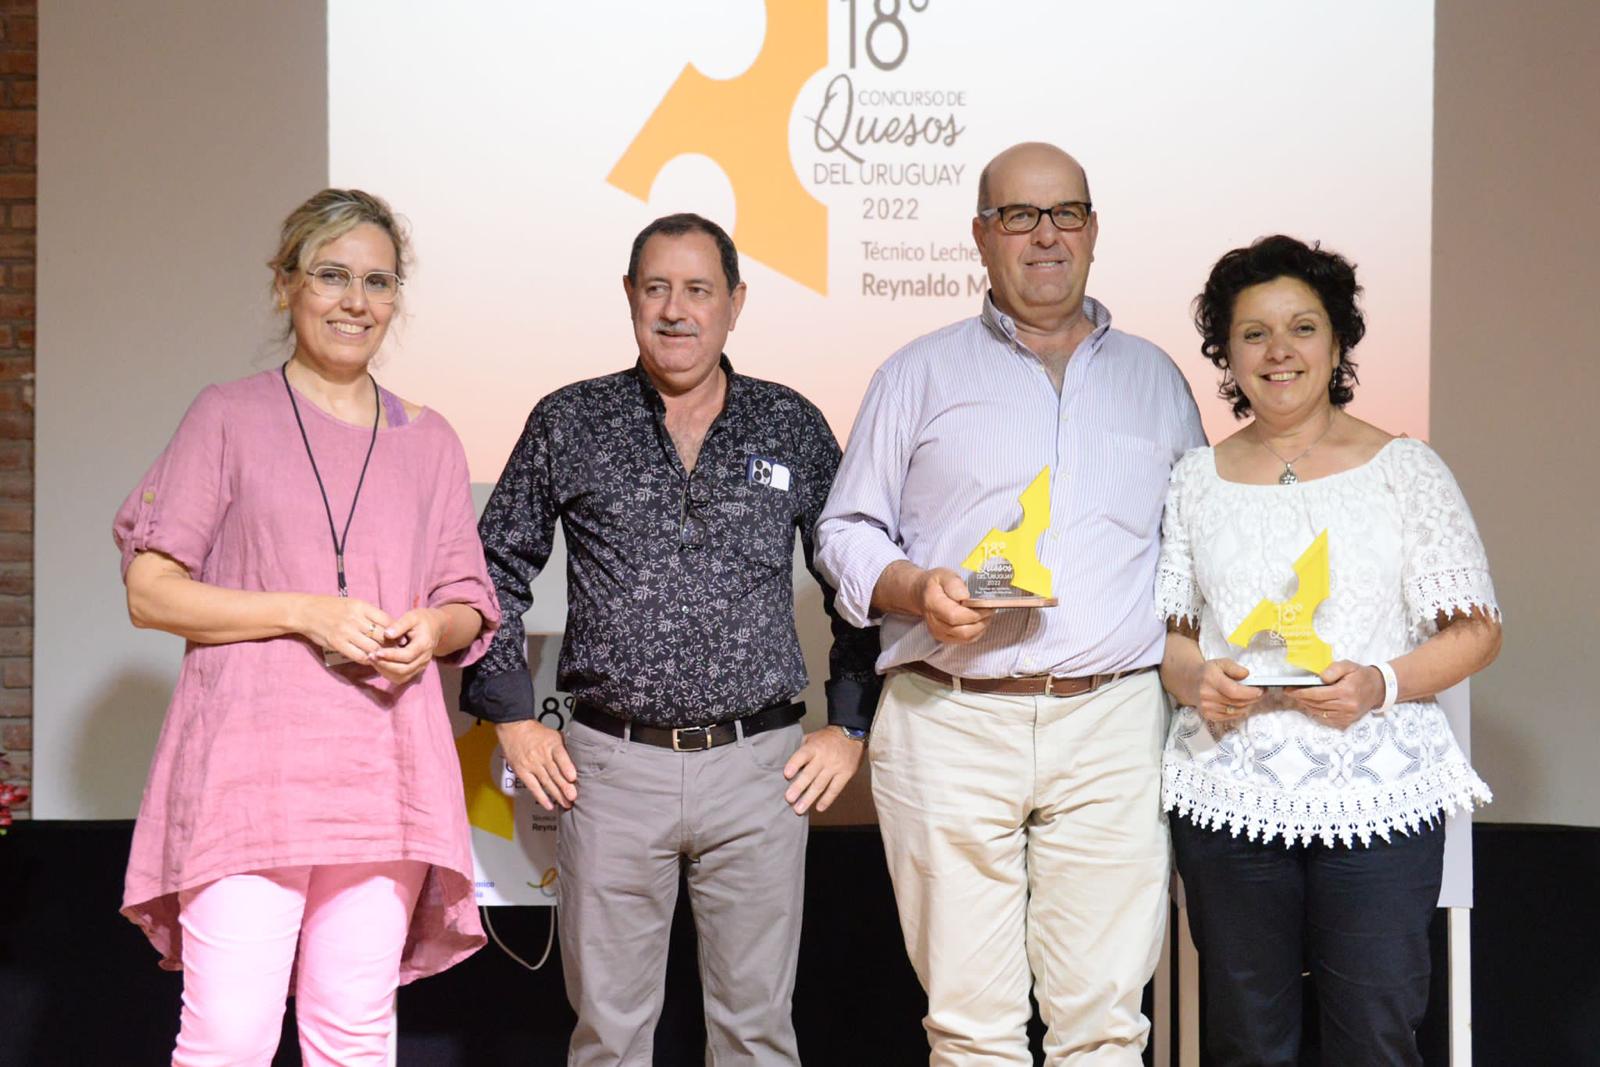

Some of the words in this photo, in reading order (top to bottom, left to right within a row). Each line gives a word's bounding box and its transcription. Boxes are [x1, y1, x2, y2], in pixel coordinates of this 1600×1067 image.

[858, 90, 945, 107] CONCURSO
[947, 91, 967, 107] DE
[803, 73, 967, 165] Quesos
[813, 163, 854, 185] DEL
[859, 163, 966, 186] URUGUAY
[862, 197, 919, 221] 2022
[861, 240, 925, 261] Técnico
[862, 272, 960, 301] Reynaldo
